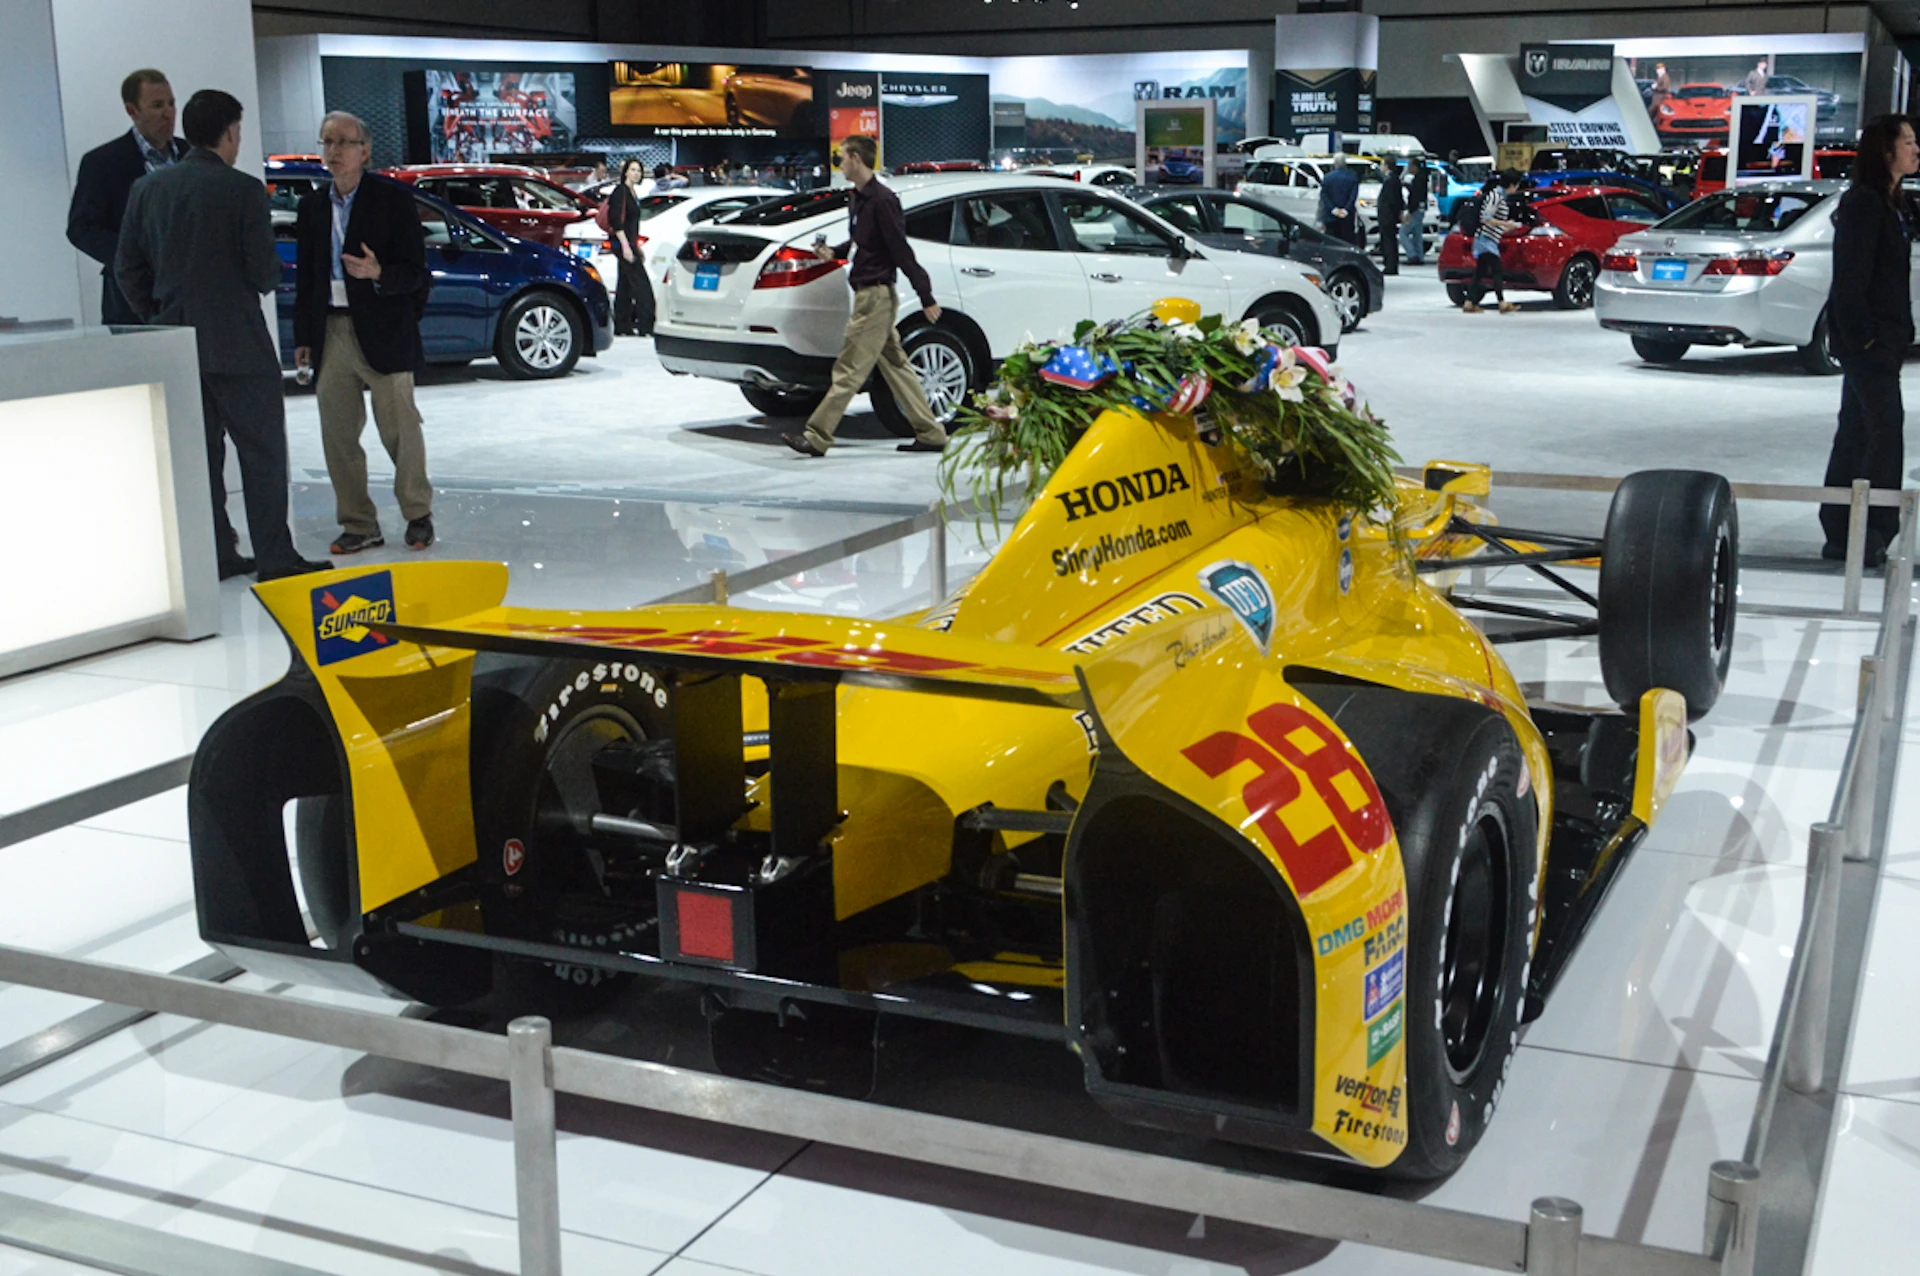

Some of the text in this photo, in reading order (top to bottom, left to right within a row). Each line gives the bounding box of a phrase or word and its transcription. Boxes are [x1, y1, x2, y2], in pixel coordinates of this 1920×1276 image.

[836, 82, 873, 99] Jeep
[881, 84, 948, 93] CHRYSLER
[1163, 86, 1236, 99] RAM
[479, 108, 498, 118] THE
[501, 108, 549, 118] SURFACE
[1291, 101, 1337, 112] TRUTH
[1579, 122, 1622, 133] GROWING
[1587, 134, 1627, 146] BRAND
[1055, 462, 1190, 522] HONDA
[1052, 519, 1193, 577] ShopHonda.com
[322, 602, 388, 636] SUNOCO
[533, 661, 668, 744] Firestone
[1179, 702, 1393, 900] 28
[1317, 916, 1365, 957] DMG
[1335, 1074, 1387, 1113] verizon
[1333, 1108, 1405, 1145] Firestone
